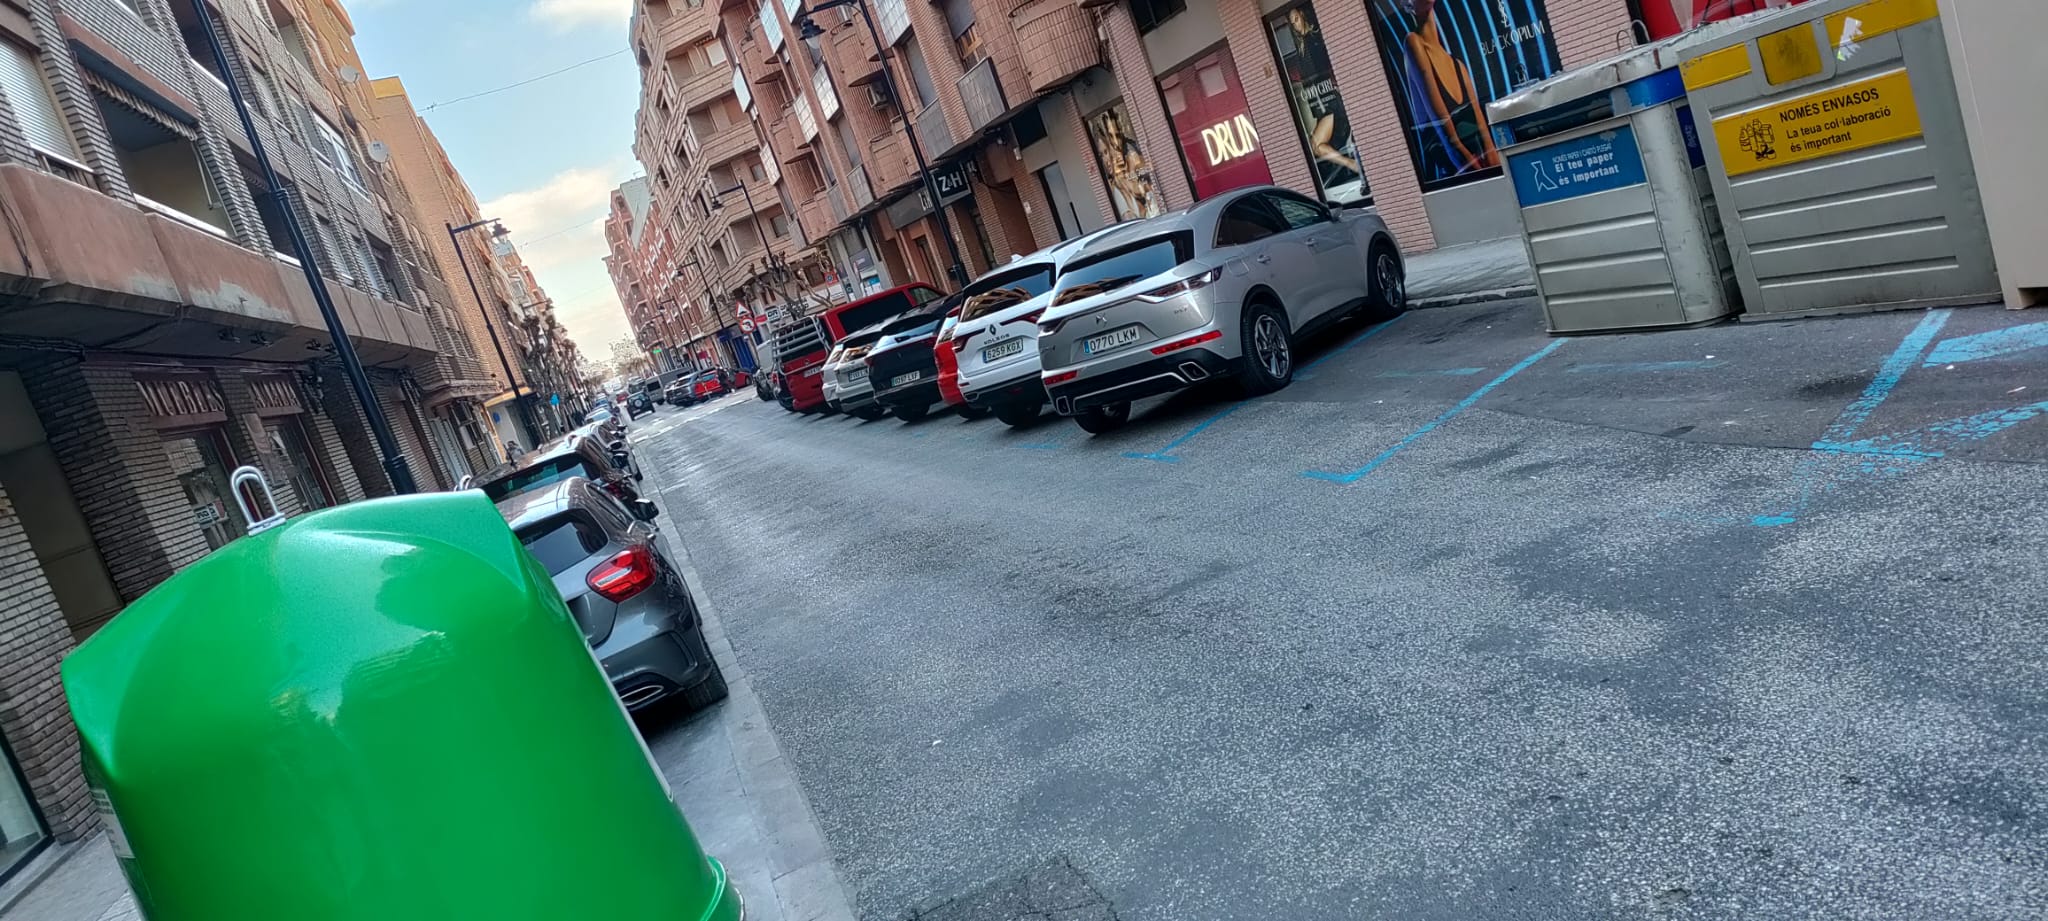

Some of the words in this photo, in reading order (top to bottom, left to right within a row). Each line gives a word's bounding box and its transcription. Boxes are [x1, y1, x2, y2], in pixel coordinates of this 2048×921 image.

[1480, 32, 1511, 56] BLACK
[1511, 19, 1545, 44] OPIUM
[1779, 101, 1820, 123] NOMÉS
[1822, 87, 1880, 113] ENVASOS
[1786, 128, 1799, 139] La
[1800, 124, 1822, 136] teua
[1790, 142, 1802, 153] és
[1804, 131, 1851, 150] important
[1555, 162, 1564, 173] El
[1568, 159, 1583, 171] teu
[1587, 152, 1613, 167] paper
[1558, 175, 1570, 186] és
[1573, 164, 1619, 182] important
[1089, 335, 1115, 351] 0770
[1116, 330, 1137, 345] LKM
